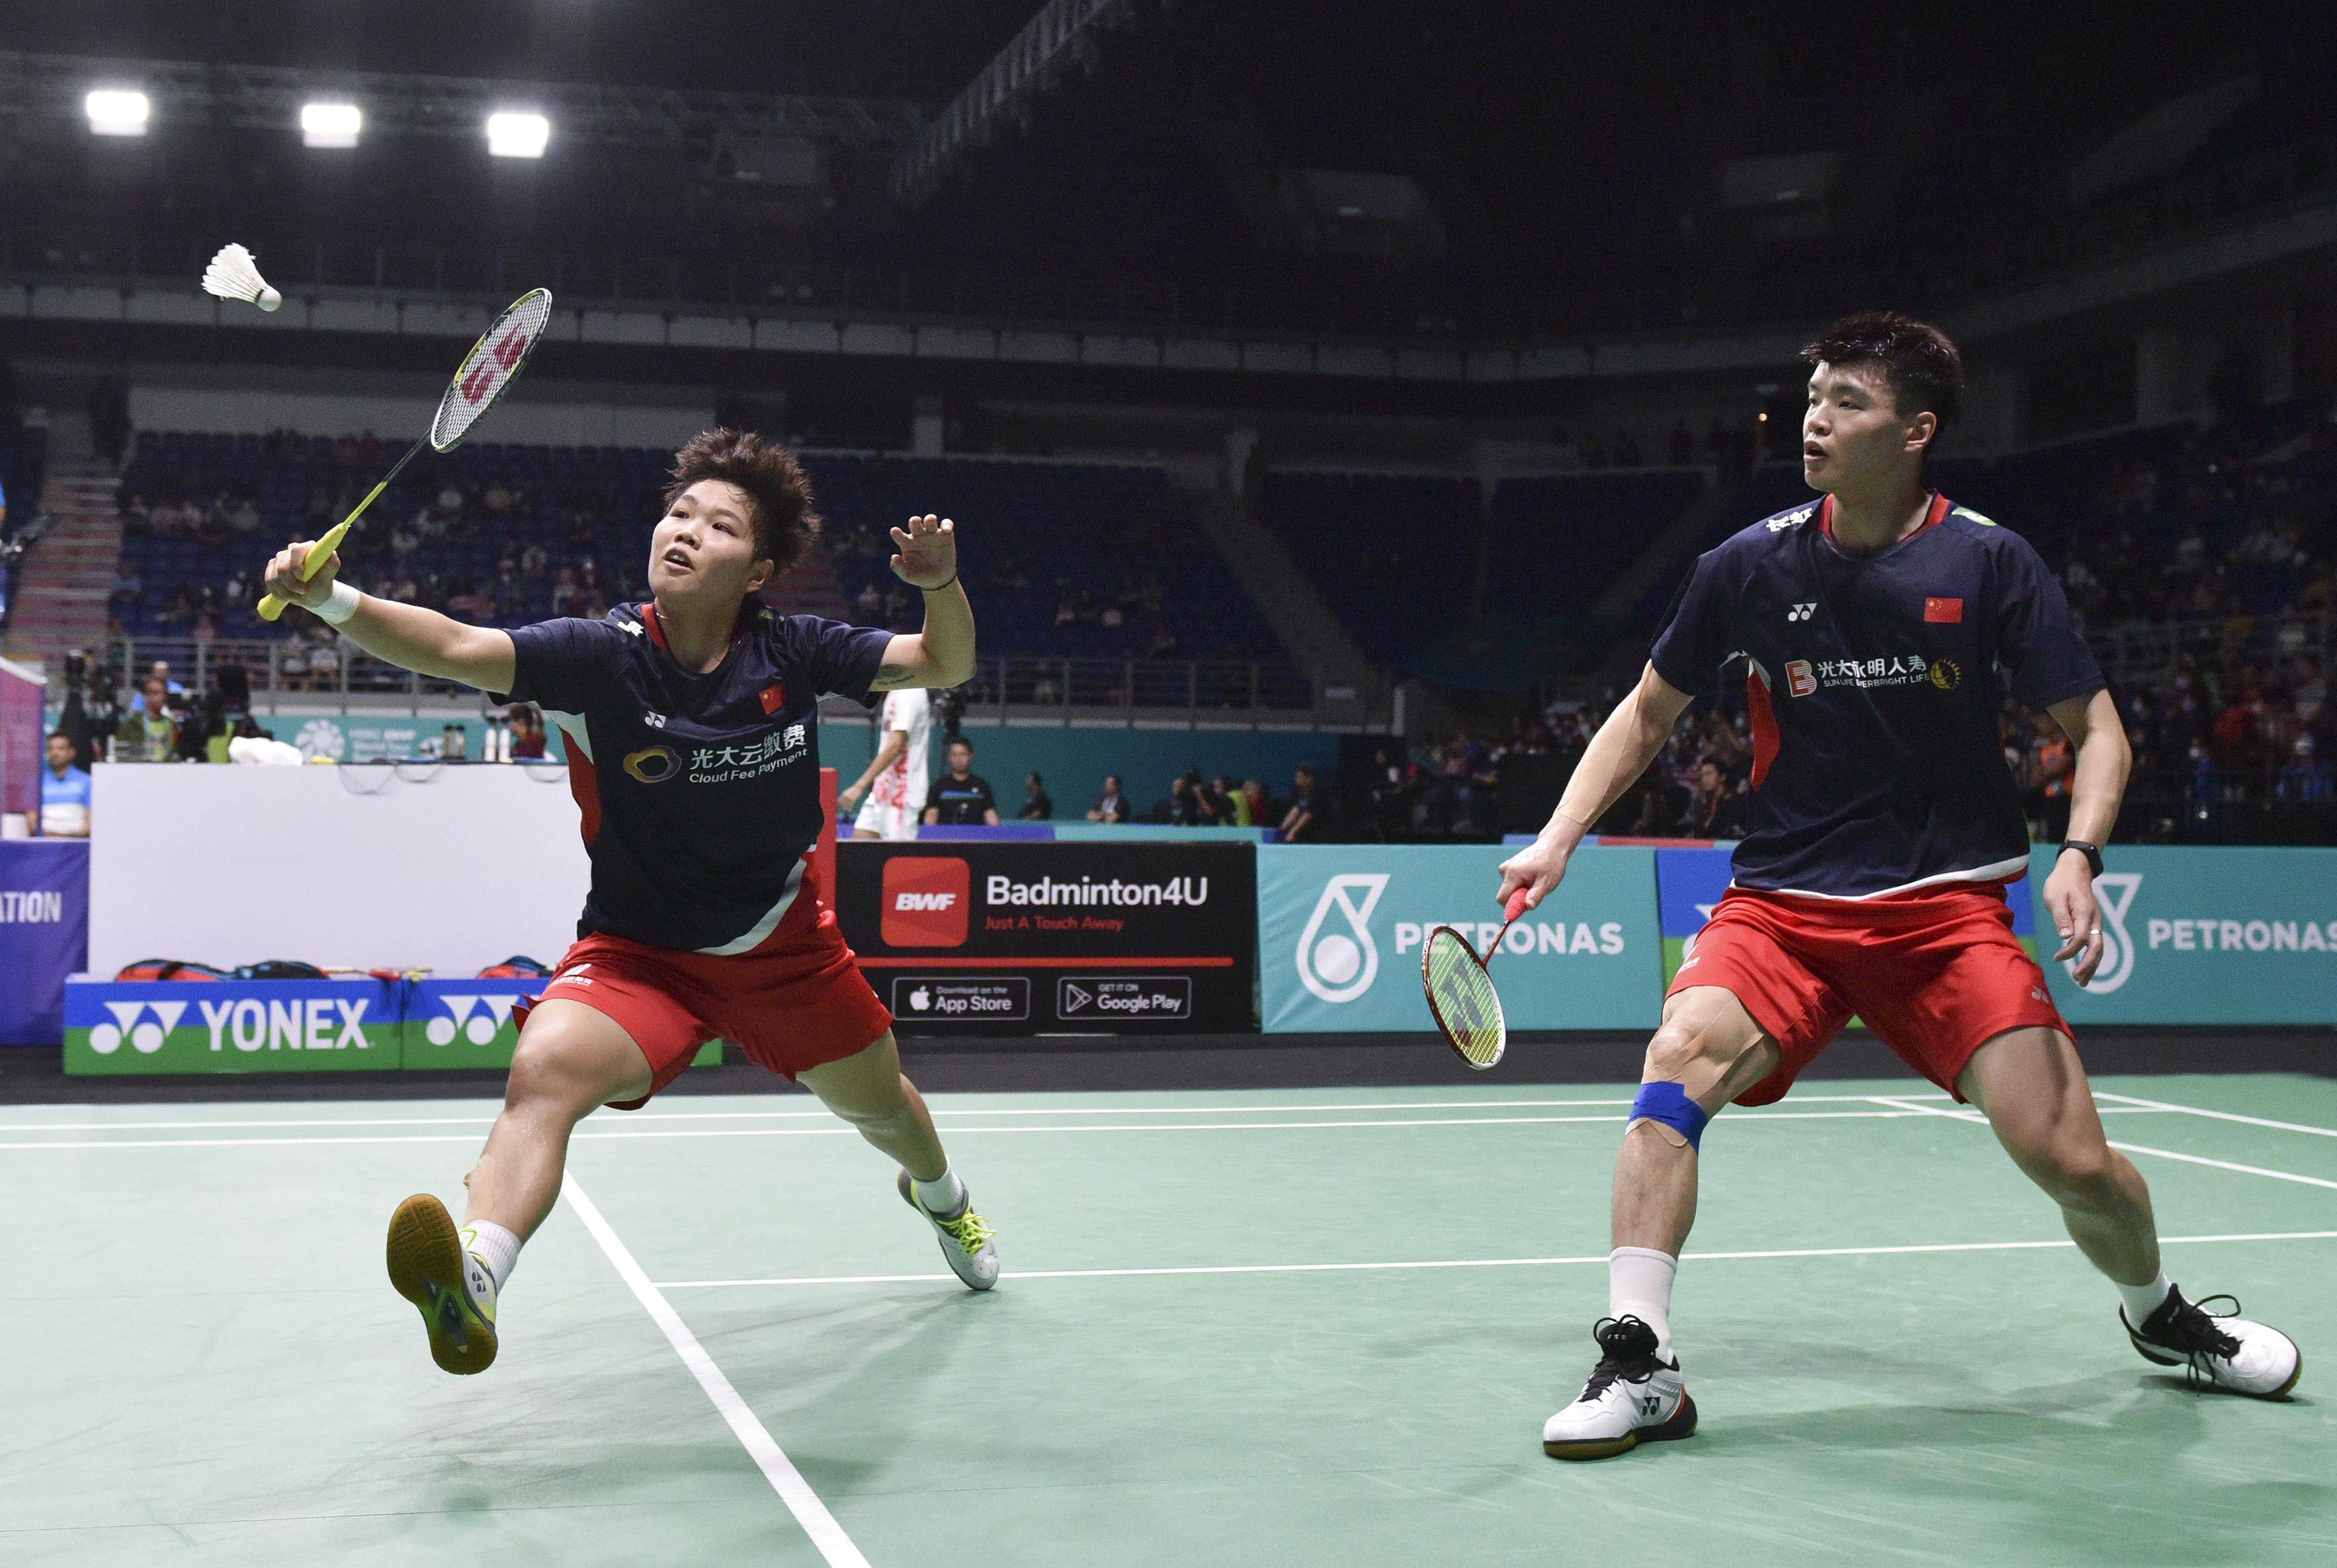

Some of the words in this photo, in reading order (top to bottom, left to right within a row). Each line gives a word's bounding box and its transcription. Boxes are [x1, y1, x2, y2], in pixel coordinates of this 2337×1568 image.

[1823, 679, 1840, 687] SUN
[1855, 677, 1907, 688] EERBRIGHT
[1910, 673, 1930, 683] LIFE
[689, 724, 806, 770] 光大云缴费
[689, 770, 728, 783] Cloud
[730, 770, 755, 780] Fee
[758, 748, 808, 775] Payment
[895, 893, 956, 911] BWF
[986, 876, 1208, 906] Badminton4U
[0, 891, 62, 923] TION
[986, 916, 1013, 930] Just
[1017, 916, 1030, 928] A
[1033, 915, 1079, 930] Touch
[1082, 916, 1124, 933] Away
[935, 995, 968, 1014] App
[970, 995, 1013, 1011] Store
[1097, 994, 1150, 1013] Google
[1152, 993, 1182, 1012] Play
[199, 999, 370, 1052] YONEX
